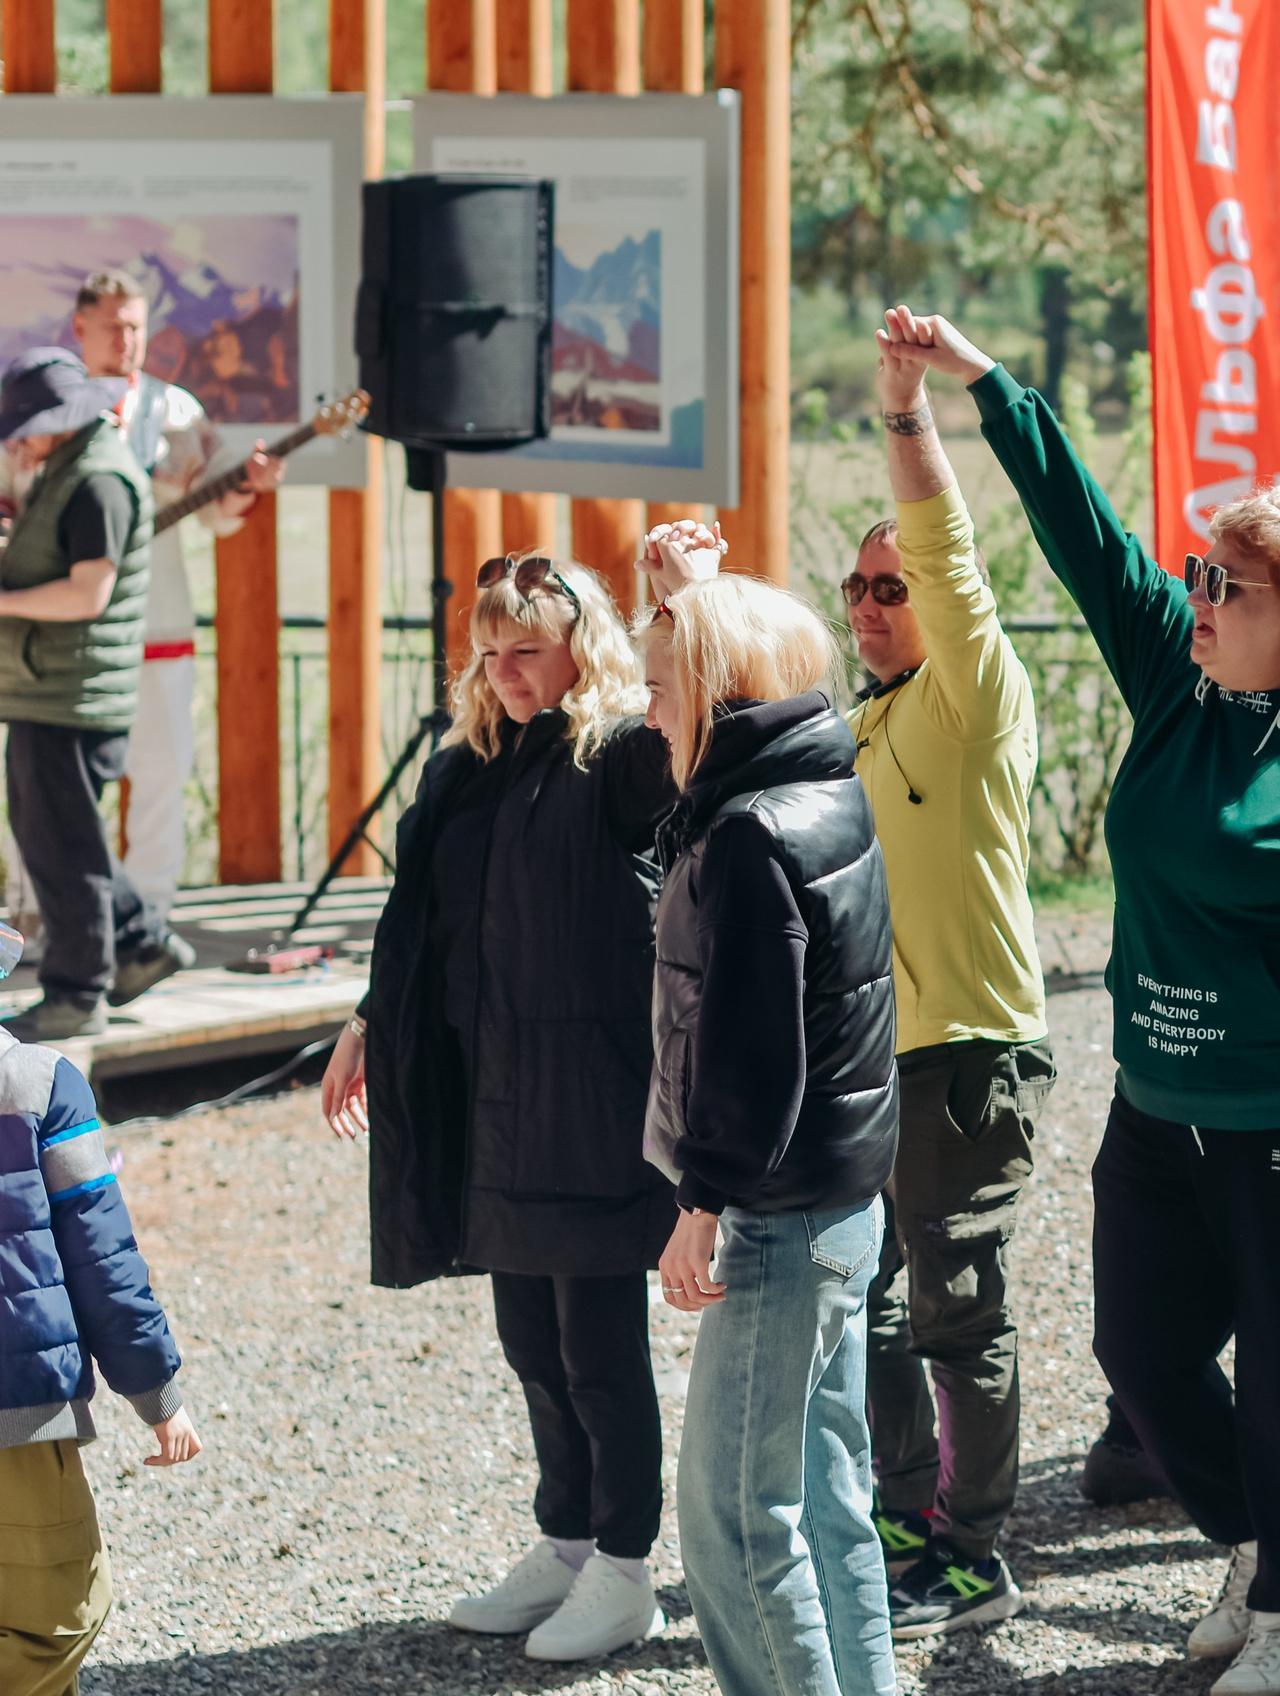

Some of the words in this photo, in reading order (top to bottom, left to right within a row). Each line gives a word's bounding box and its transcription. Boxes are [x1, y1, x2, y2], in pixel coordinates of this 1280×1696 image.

[1138, 973, 1202, 1001] EVERYTHING
[1206, 991, 1218, 1003] IS
[1150, 1000, 1199, 1021] AMAZING
[1131, 1012, 1150, 1028] AND
[1153, 1019, 1225, 1041] EVERYBODY
[1148, 1035, 1158, 1048] IS
[1160, 1040, 1198, 1057] HAPPY
